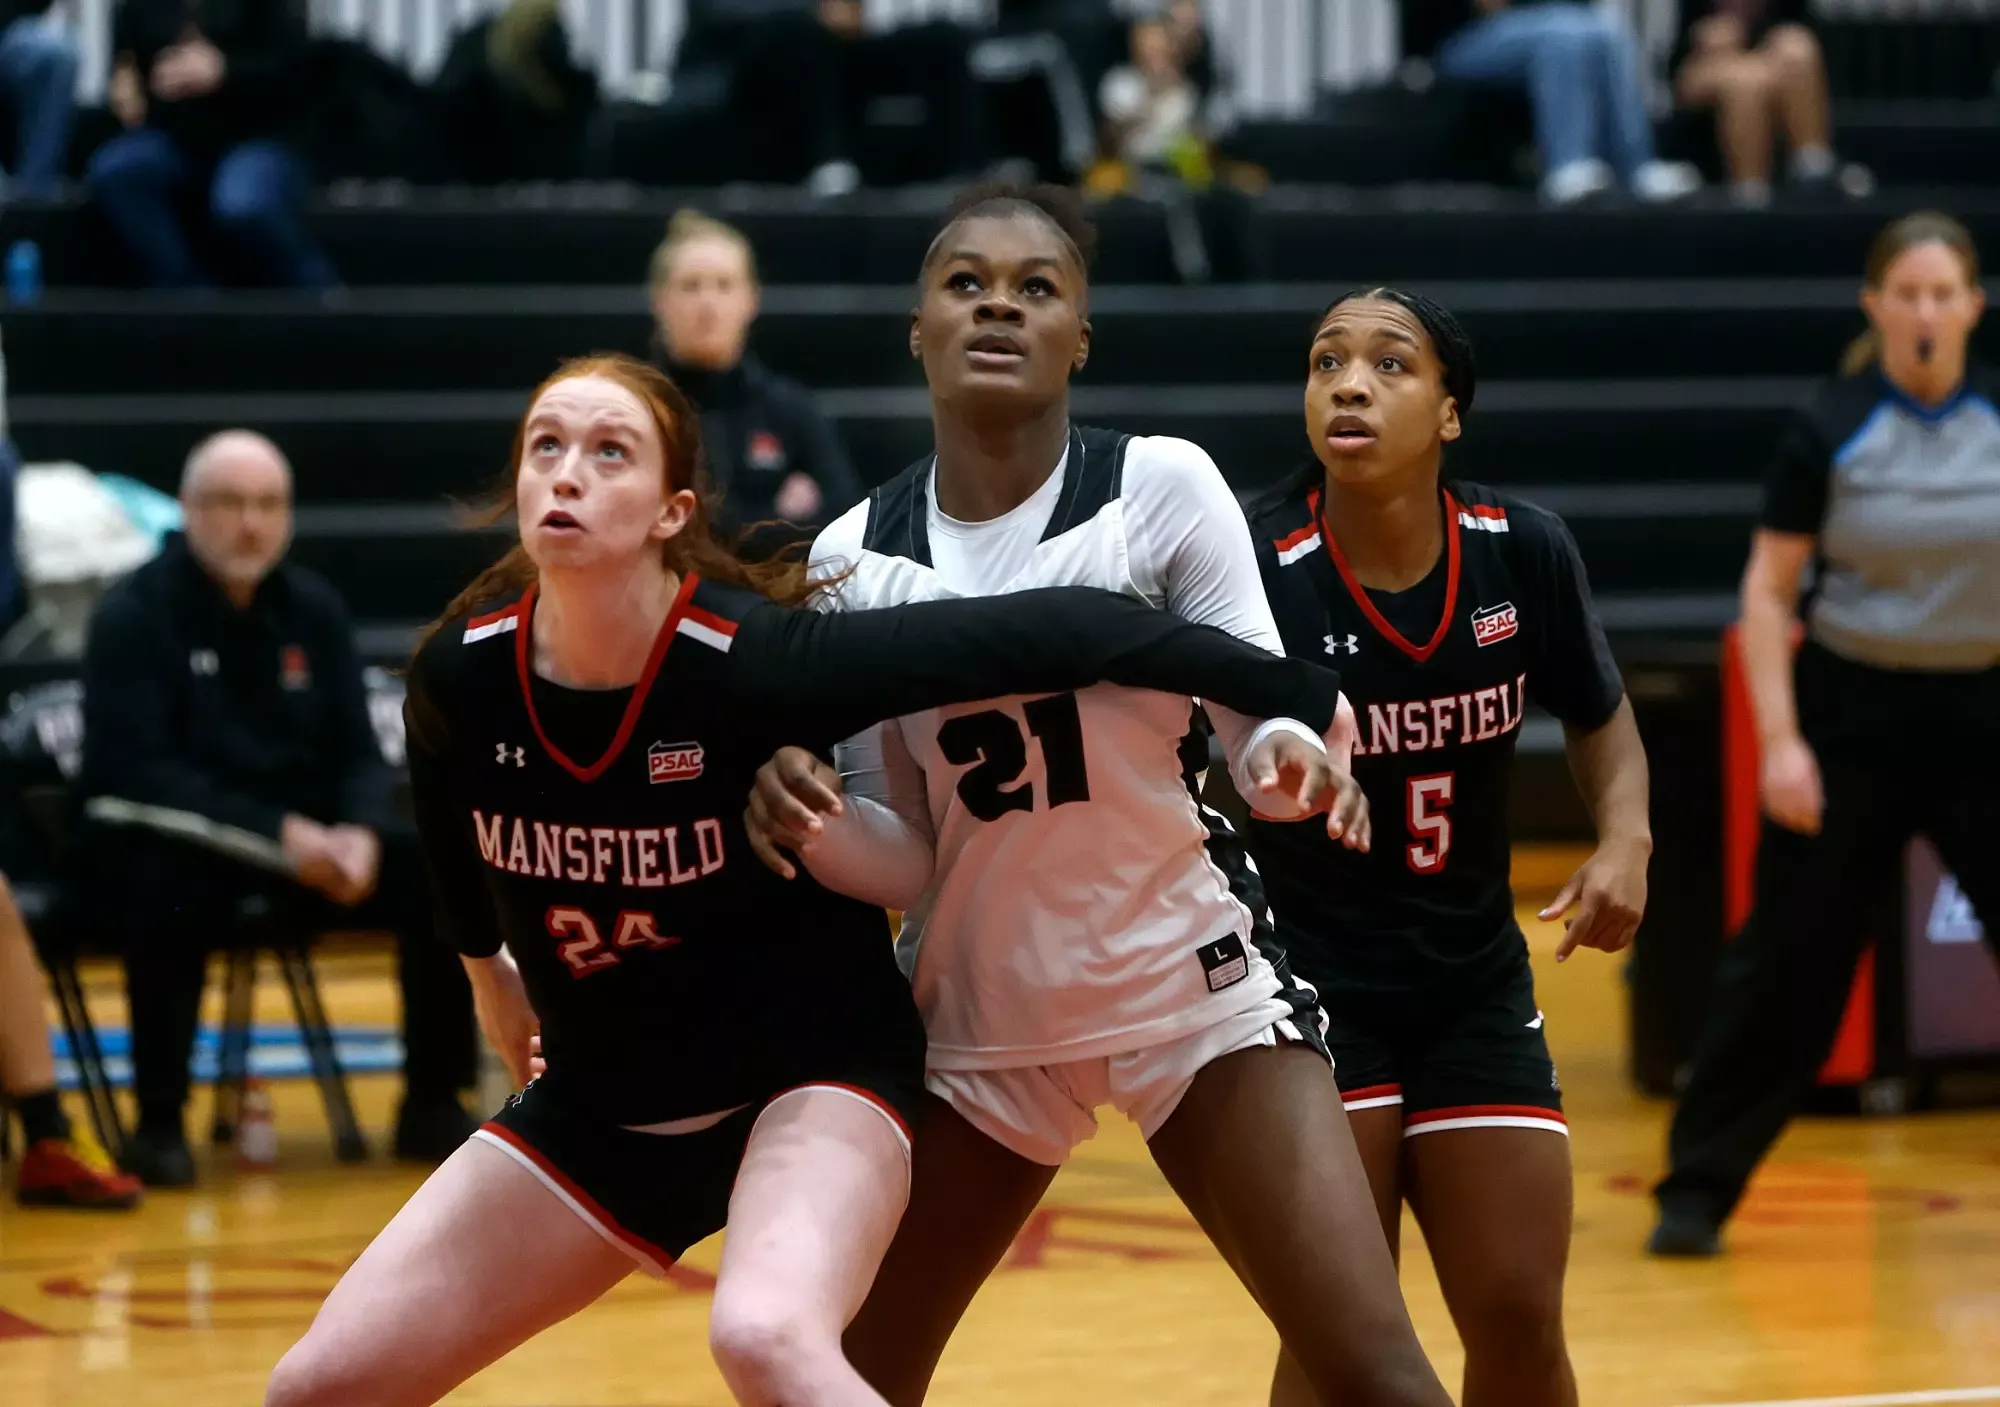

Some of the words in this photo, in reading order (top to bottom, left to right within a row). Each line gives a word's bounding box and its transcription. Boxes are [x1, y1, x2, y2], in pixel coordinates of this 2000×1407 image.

[1475, 610, 1516, 637] PSAC
[1350, 671, 1526, 756] ANSFIELD
[651, 751, 701, 772] PSAC
[936, 689, 1091, 822] 21
[472, 808, 726, 888] MANSFIELD
[1406, 770, 1455, 875] 5
[545, 904, 682, 980] 24
[1214, 946, 1229, 961] L
